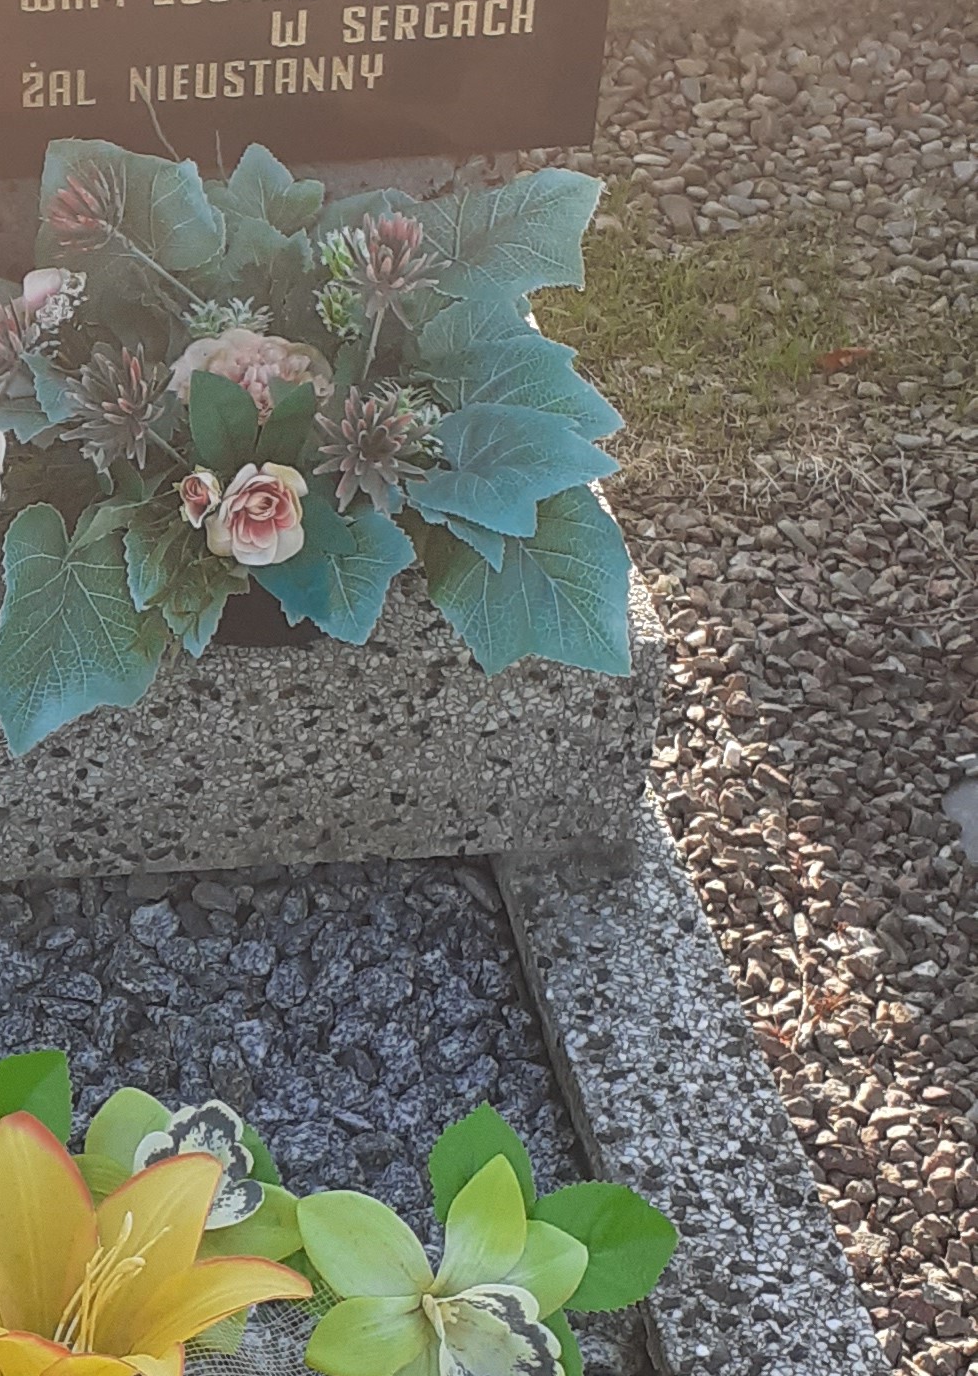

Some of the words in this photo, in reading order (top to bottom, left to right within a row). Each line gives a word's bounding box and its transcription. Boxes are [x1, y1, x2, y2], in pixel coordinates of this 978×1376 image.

[271, 9, 308, 48] W
[22, 61, 97, 108] ŻAL
[129, 53, 384, 103] NIEUSTANNY
